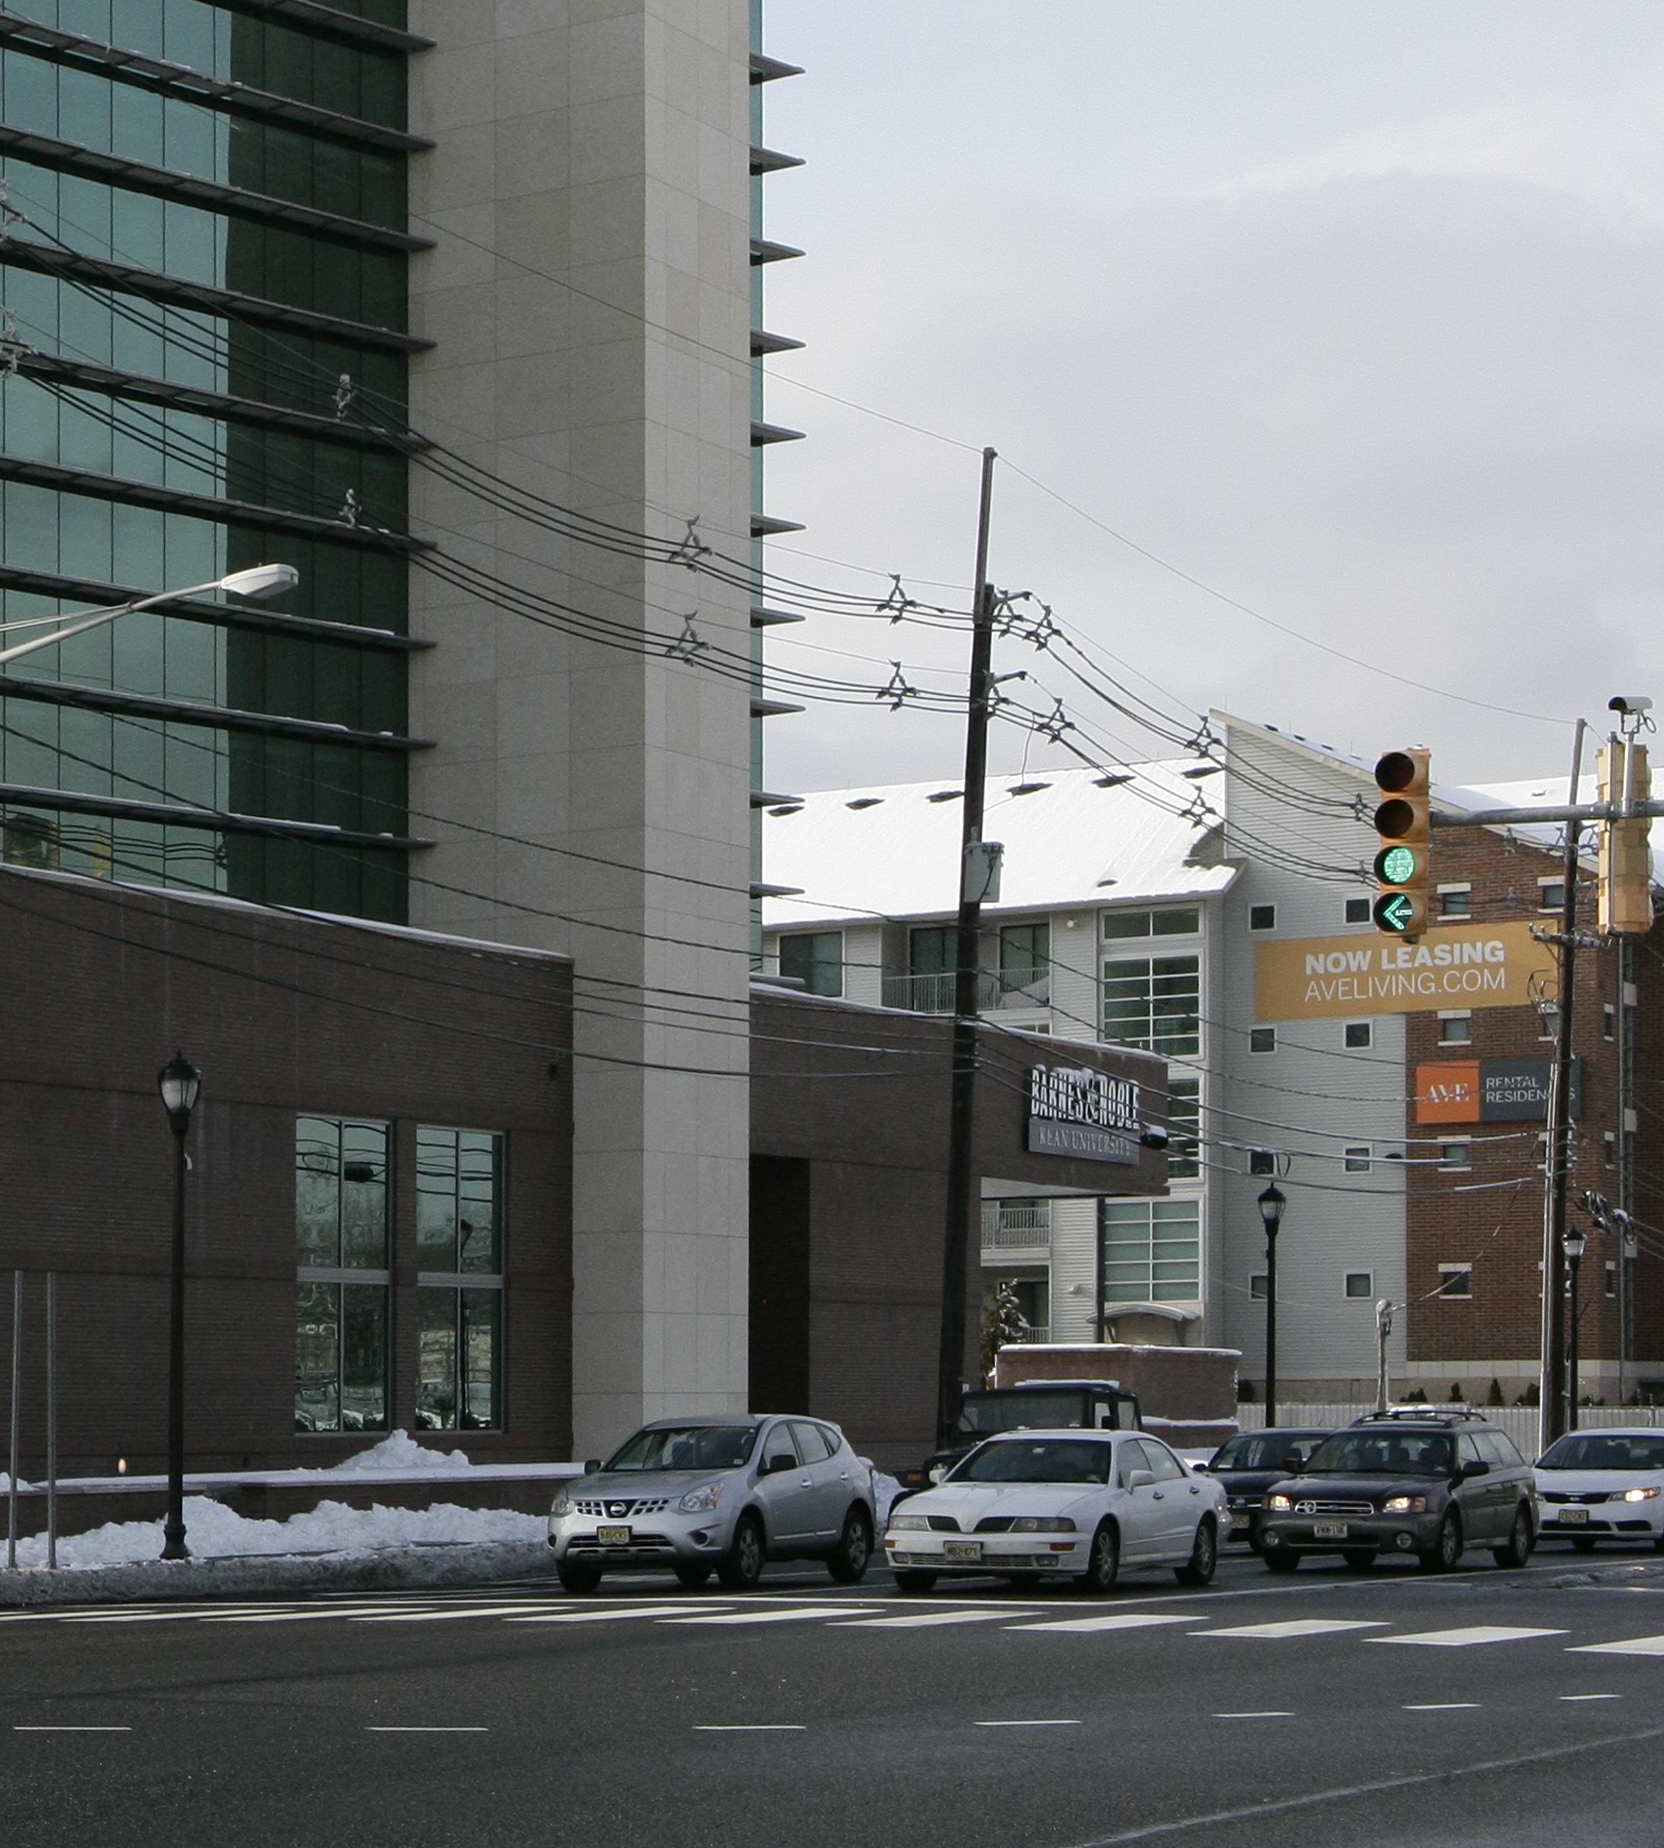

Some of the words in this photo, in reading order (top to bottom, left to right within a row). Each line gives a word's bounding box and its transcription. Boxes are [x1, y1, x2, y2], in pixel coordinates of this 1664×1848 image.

[1305, 950, 1372, 976] NOW
[1380, 940, 1505, 971] LEASING
[1304, 967, 1506, 1002] AVELIVING.COM
[1031, 1066, 1083, 1122] BARNES
[1085, 1072, 1100, 1124] &
[1099, 1076, 1141, 1130] NOBLE
[1485, 1087, 1576, 1103] RESIDENS
[1486, 1076, 1541, 1089] RENTAL
[1039, 1127, 1069, 1148] KEAN
[1071, 1129, 1131, 1157] UNIVERSITY
